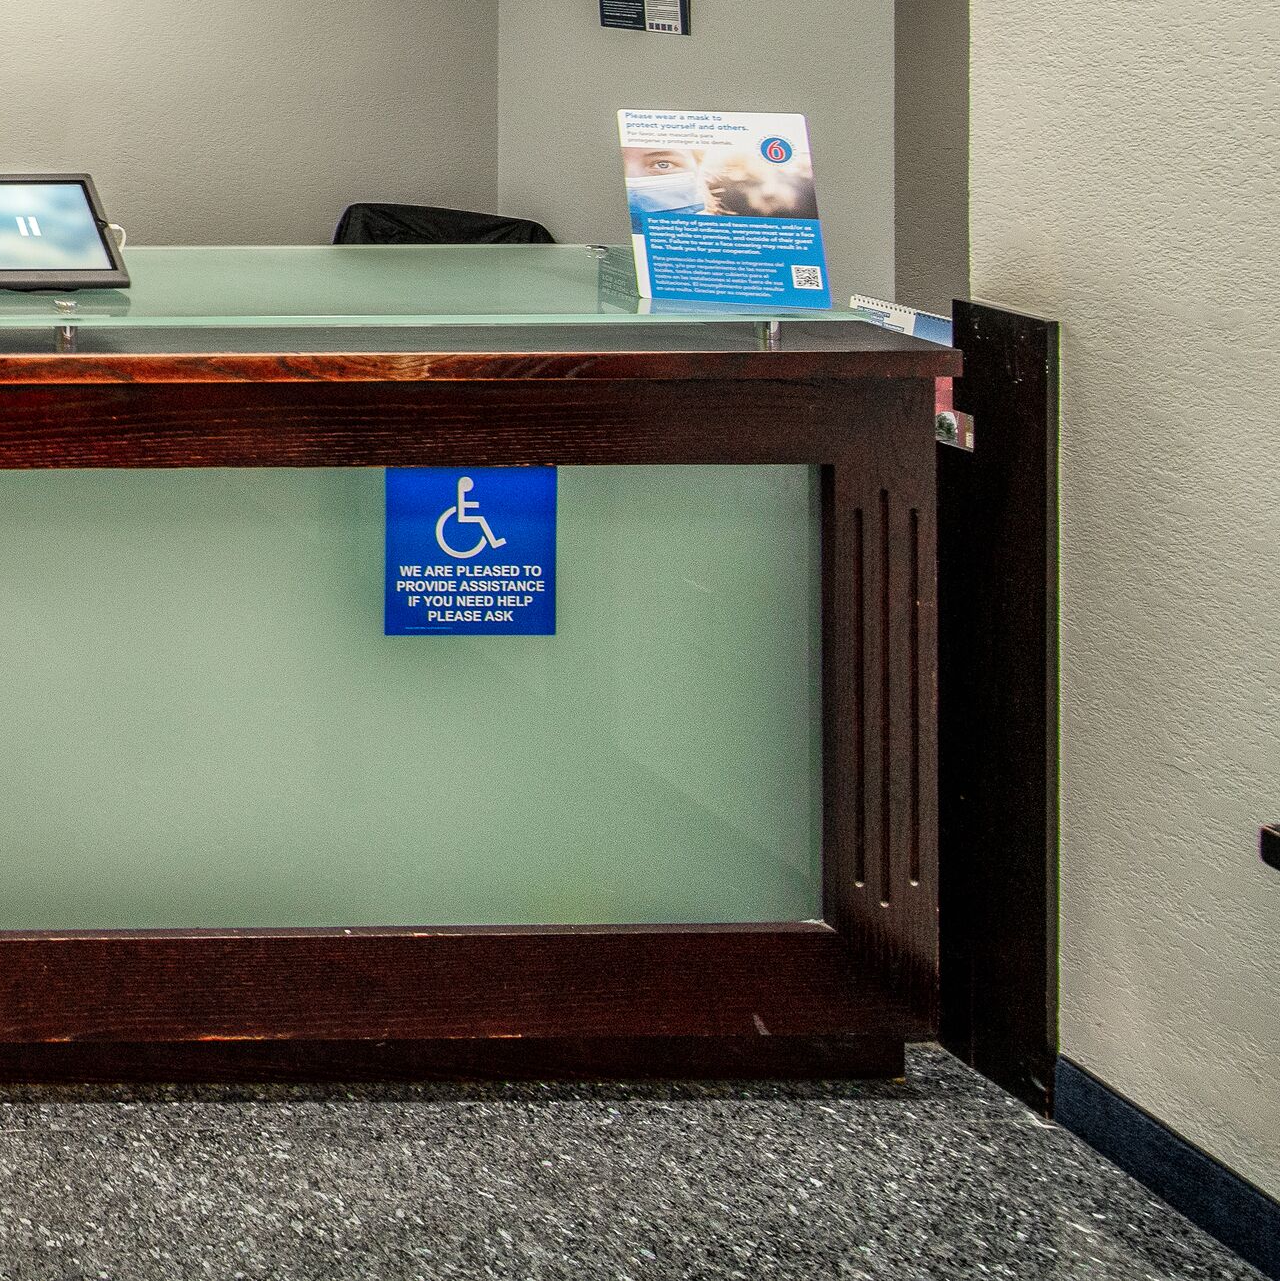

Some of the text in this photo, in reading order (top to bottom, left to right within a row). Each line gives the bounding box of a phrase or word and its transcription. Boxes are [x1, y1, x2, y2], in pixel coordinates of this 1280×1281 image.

[626, 122, 659, 130] protect
[661, 123, 697, 131] yourself
[717, 123, 749, 131] others.
[766, 140, 785, 160] 6
[399, 566, 542, 577] WE ARE PLEASED TO
[396, 580, 545, 592] PROVIDE ASSISTANCE
[408, 596, 533, 607] IF YOU NEED HELP
[428, 611, 513, 622] PLEASE ASK
